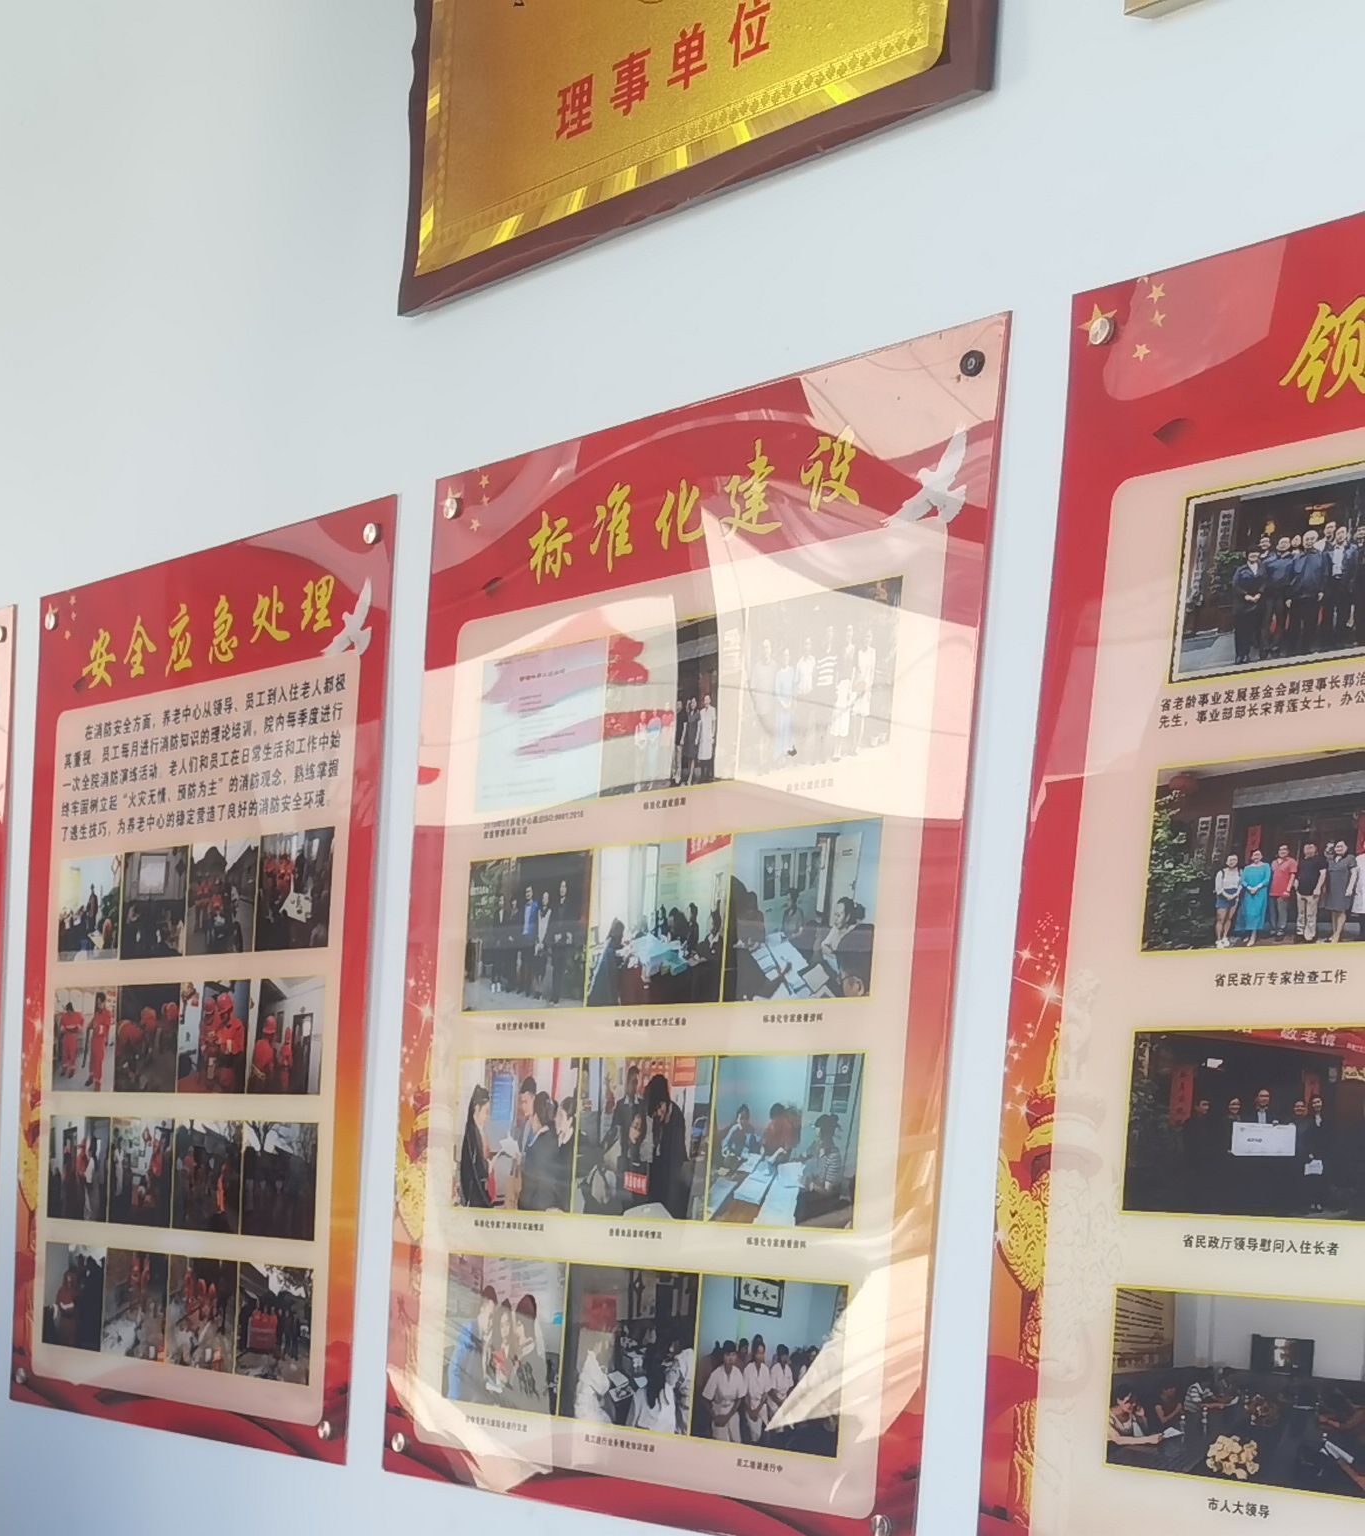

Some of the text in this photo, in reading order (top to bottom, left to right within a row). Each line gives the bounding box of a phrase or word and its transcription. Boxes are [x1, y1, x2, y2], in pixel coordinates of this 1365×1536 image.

[554, 0, 772, 142] 理事单位
[527, 425, 862, 586] 标准化建设
[82, 574, 336, 691] 安全应急处理
[1214, 969, 1348, 988] 省民政厅专家检查工作
[1182, 1233, 1340, 1257] 省民政厅领导慰问入住长者
[1207, 1496, 1271, 1519] 市人大领导
